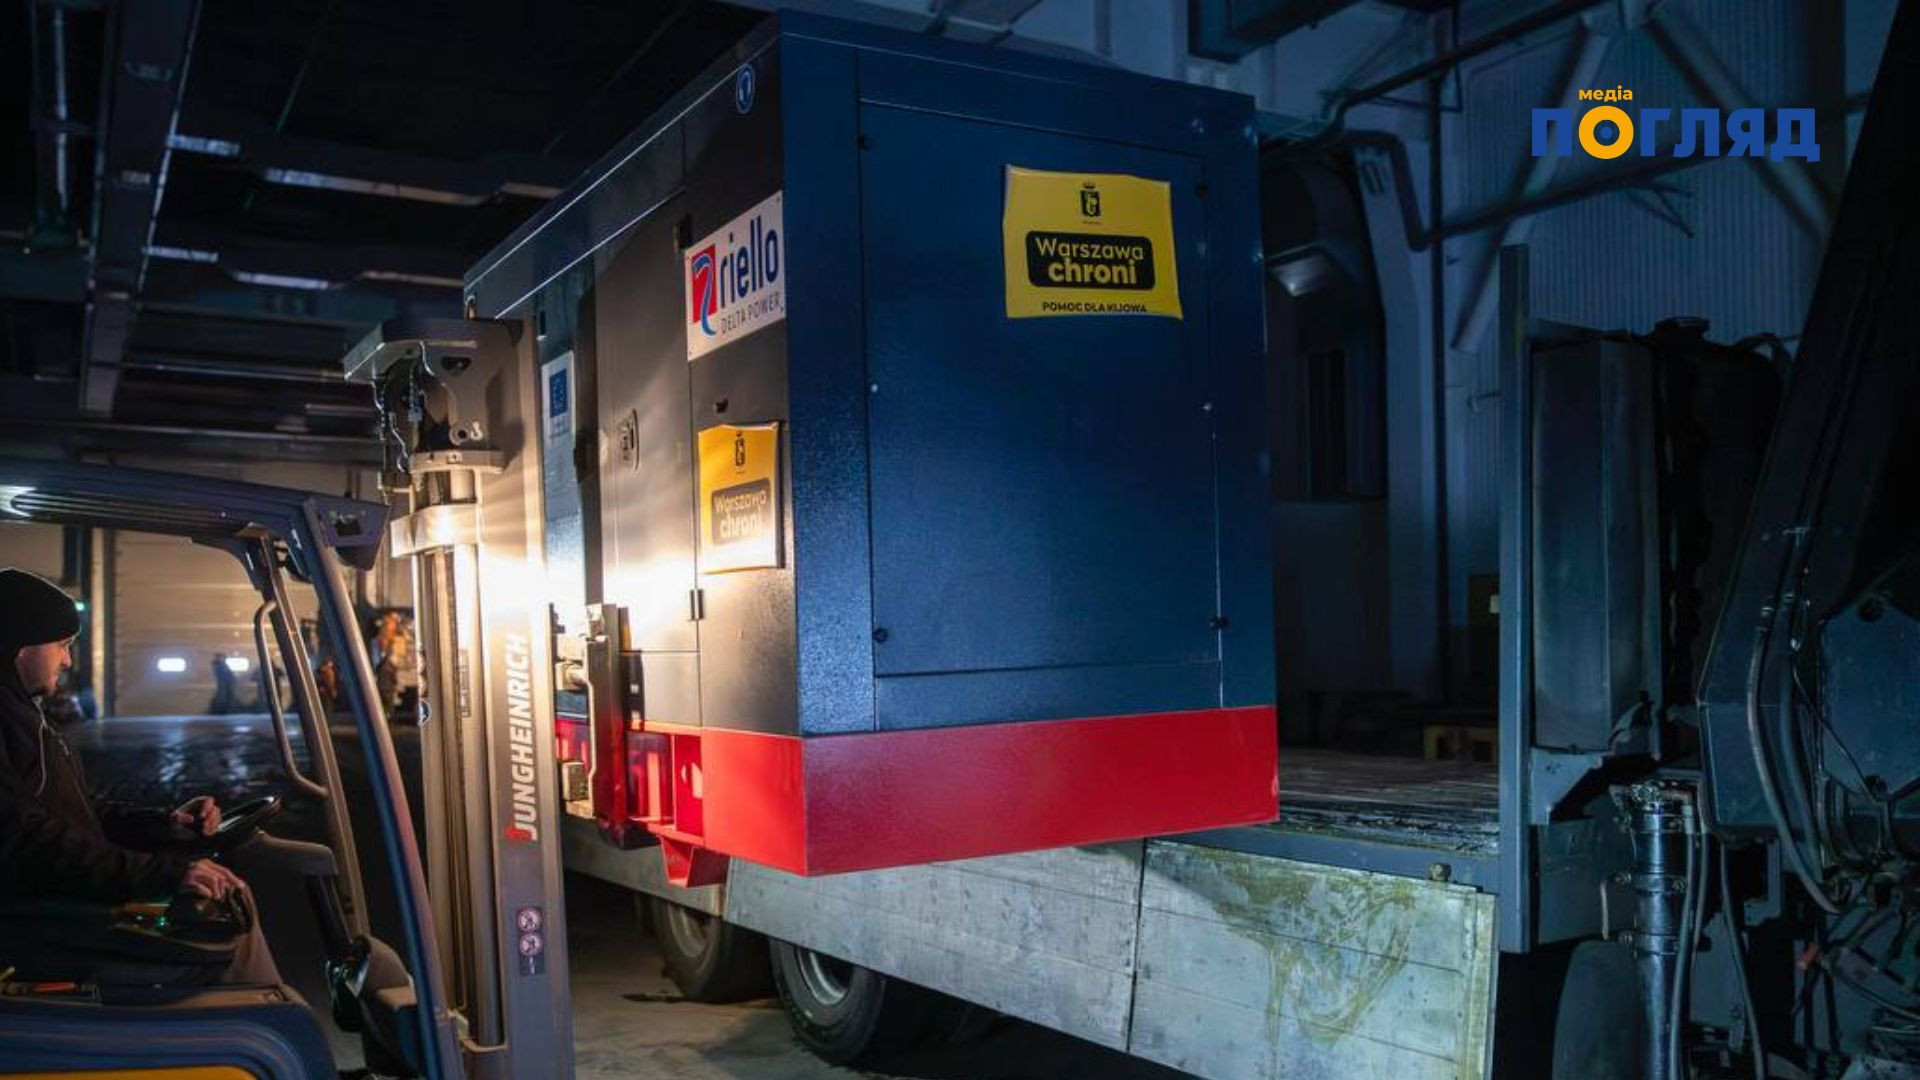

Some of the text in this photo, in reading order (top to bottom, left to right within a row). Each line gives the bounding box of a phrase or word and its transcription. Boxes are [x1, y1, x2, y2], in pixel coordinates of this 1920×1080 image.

[719, 214, 780, 308] riello
[1036, 237, 1144, 260] Warszawa
[1048, 258, 1137, 284] chroni
[721, 292, 780, 334] DELTA POWER
[1042, 301, 1083, 312] POMOC
[1084, 302, 1105, 312] DLA
[714, 490, 767, 513] Warszawa
[719, 505, 761, 538] chroni
[506, 632, 538, 843] JUNGHEINRICH
